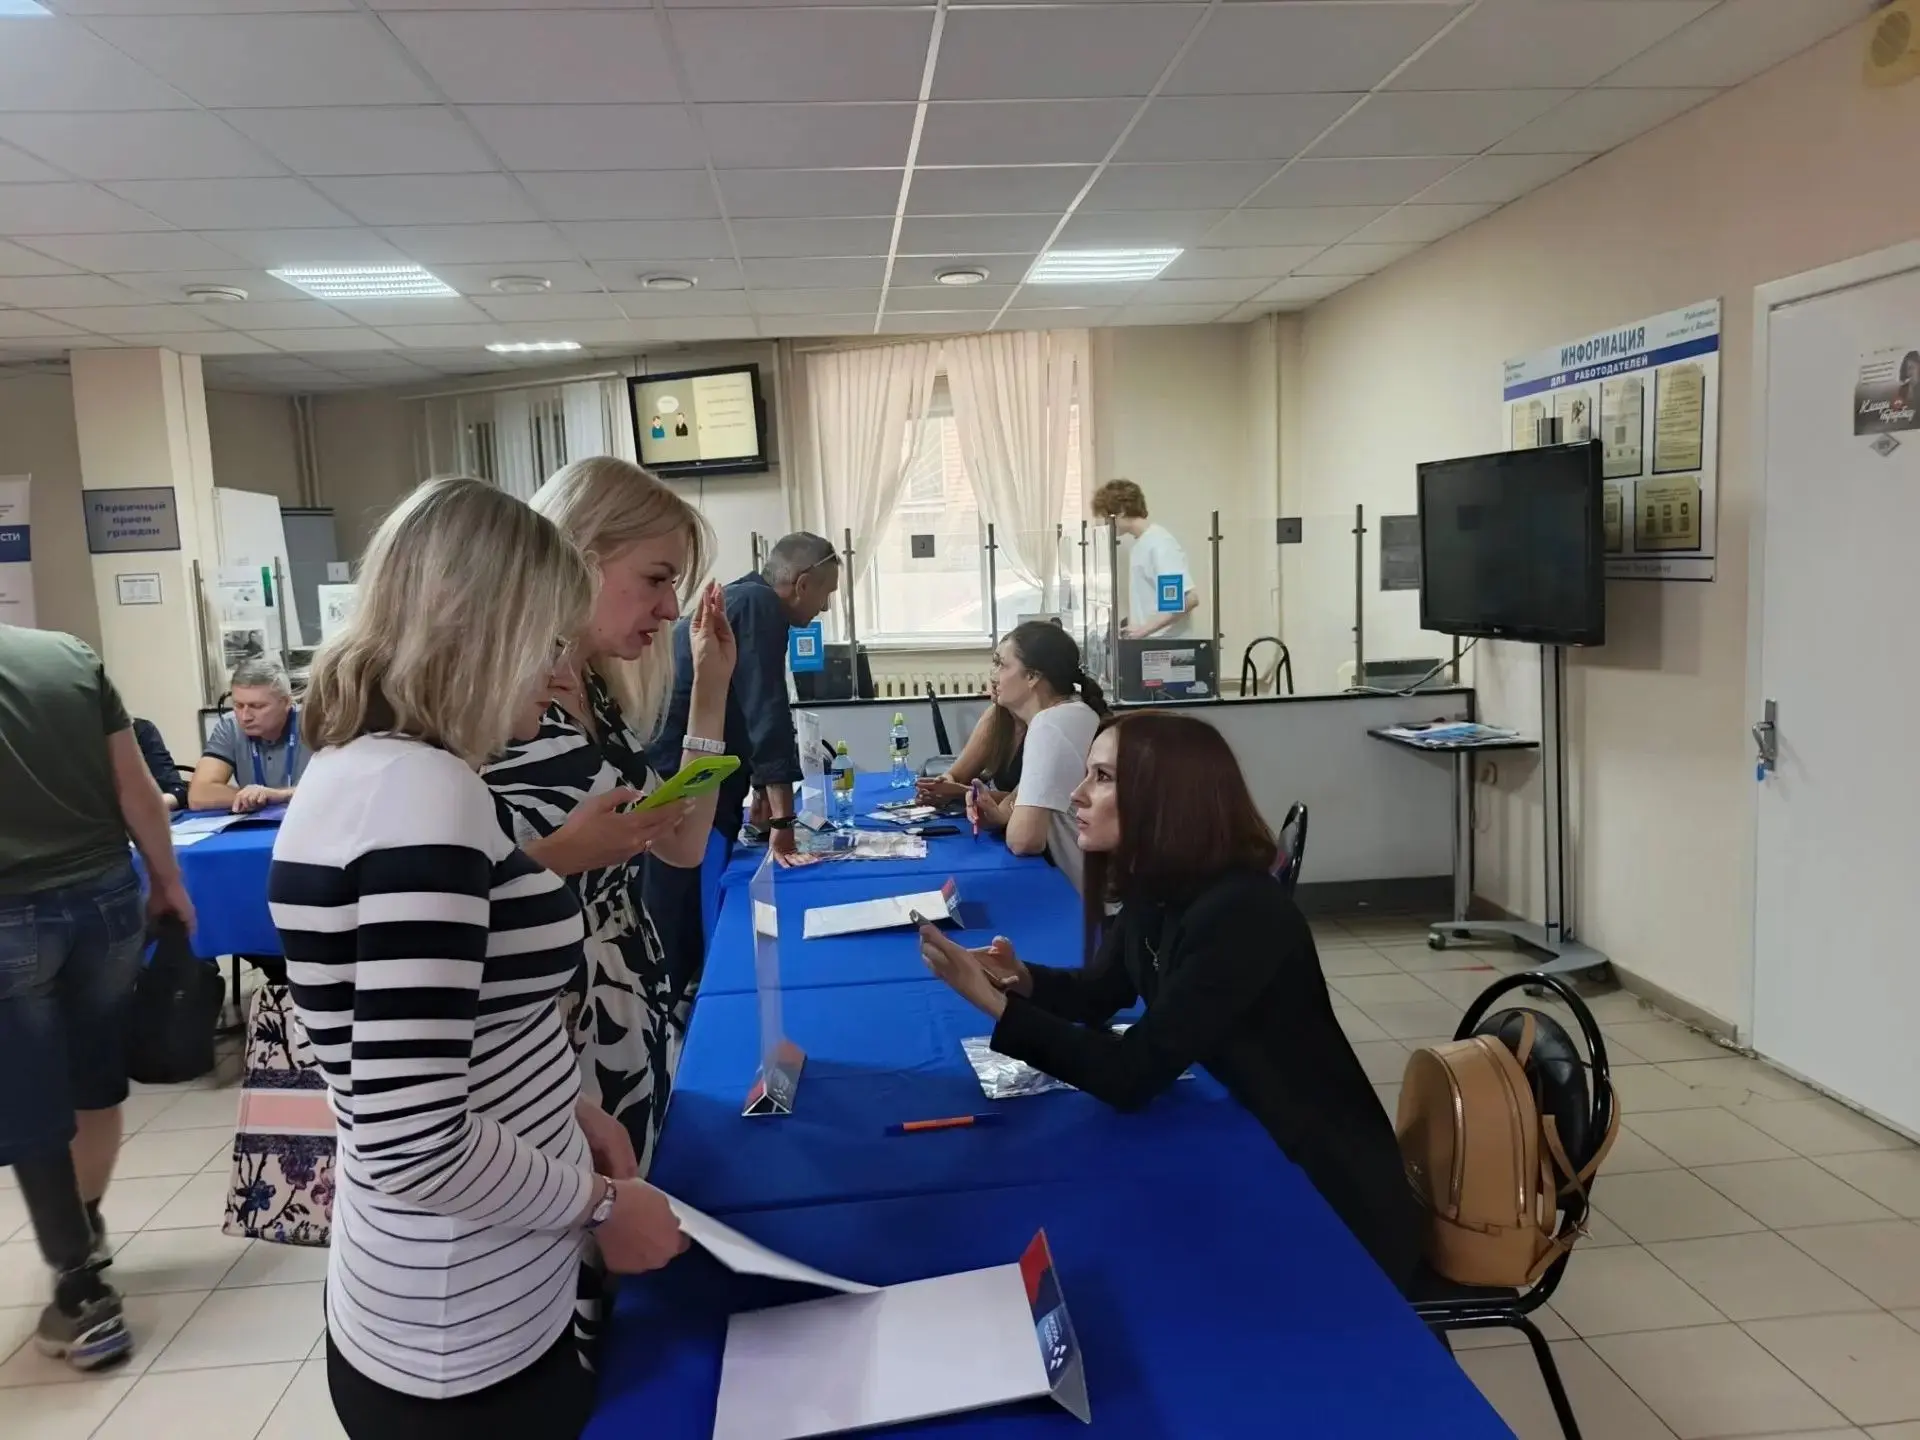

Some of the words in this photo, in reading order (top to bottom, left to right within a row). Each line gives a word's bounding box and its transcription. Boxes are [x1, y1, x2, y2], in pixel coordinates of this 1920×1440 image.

[1561, 326, 1645, 368] ИНФОРМАЦИЯ
[1550, 373, 1567, 388] ДЛЯ
[1574, 354, 1648, 381] РАБОТОДАТЕЛЕЙ
[95, 502, 166, 514] Первичный
